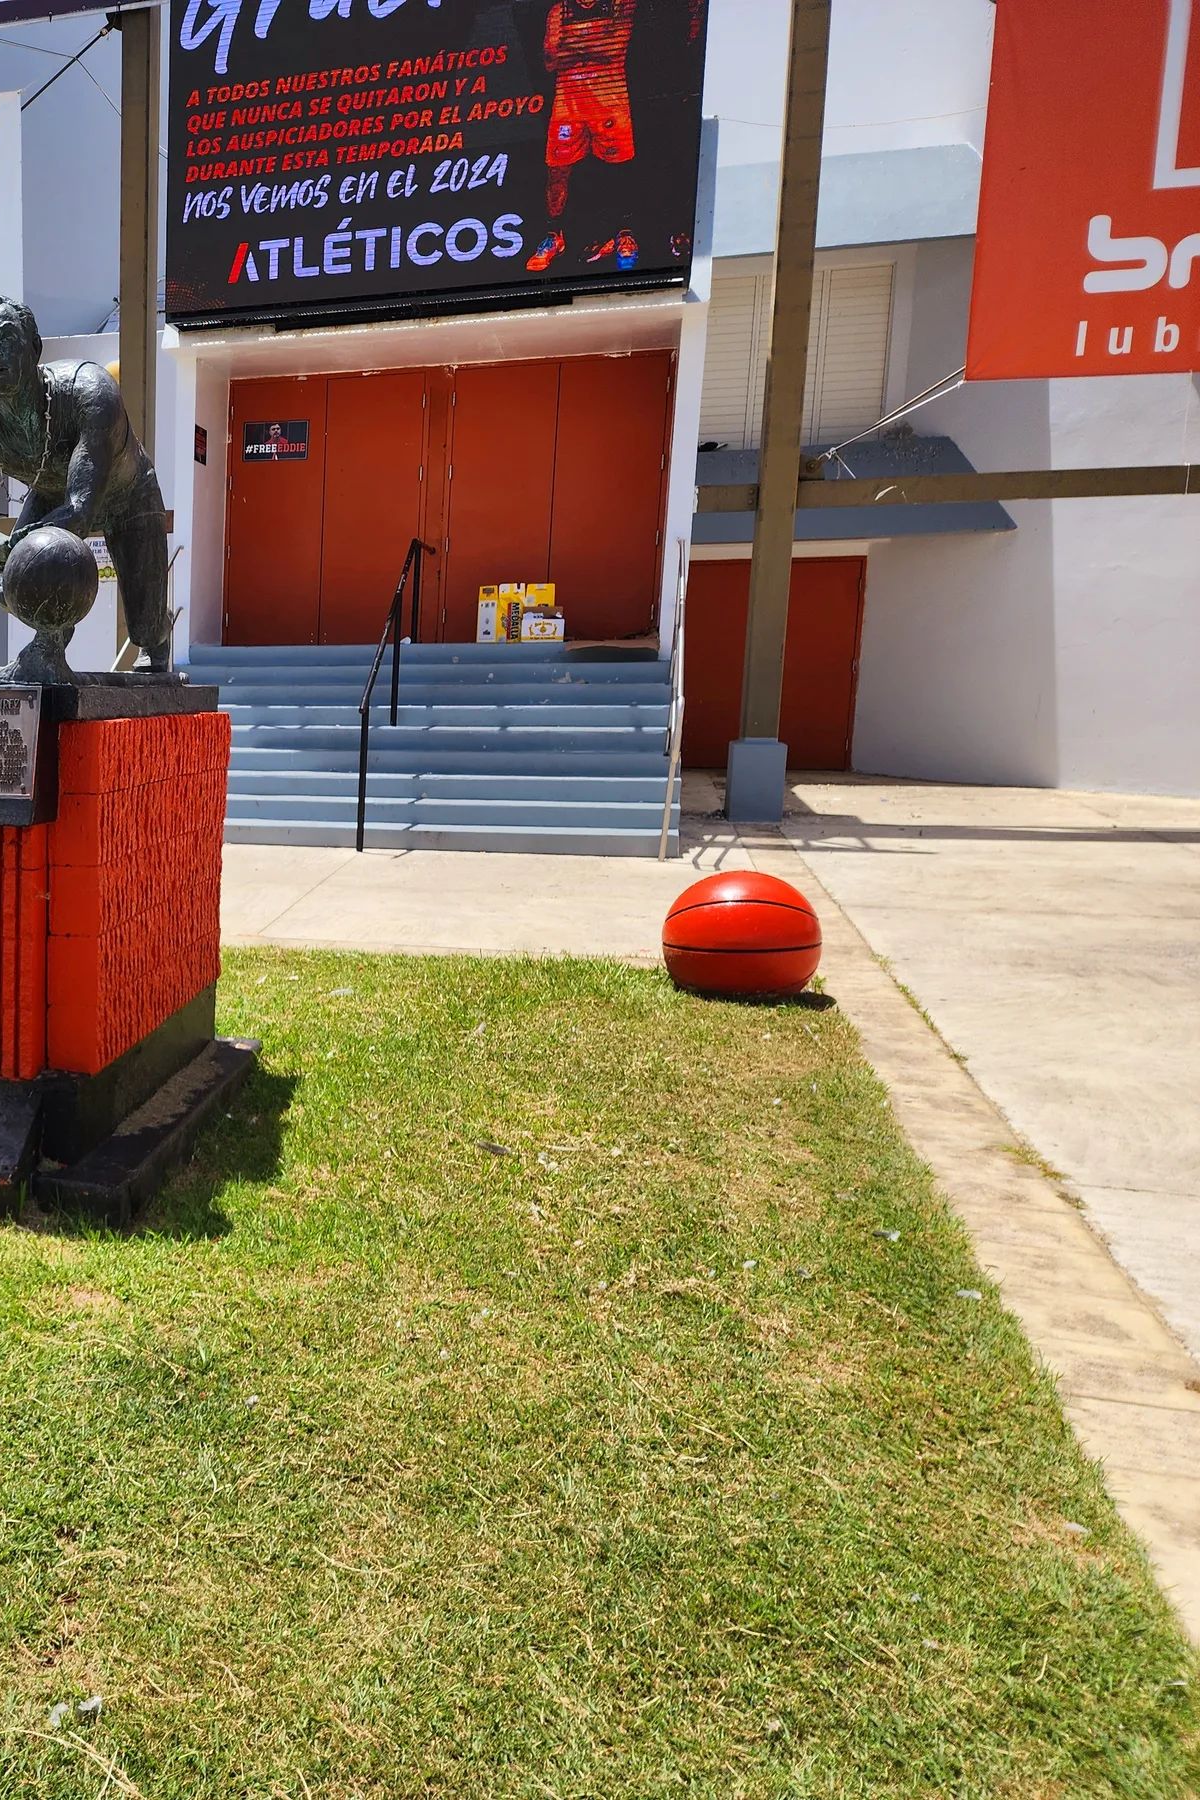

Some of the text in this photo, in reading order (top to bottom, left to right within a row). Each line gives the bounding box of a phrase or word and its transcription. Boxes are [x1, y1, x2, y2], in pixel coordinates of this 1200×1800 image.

[186, 45, 508, 107] A TODOS NUESTROS FANÁTICOS
[186, 76, 486, 135] QUE NUNCA SE QUITARON Y A
[186, 94, 544, 157] LOS AUSPICIADORES POR EL APOYO
[185, 131, 464, 183] DURANTE ESTA TEMPORADA
[240, 174, 332, 214] VEMOS
[430, 153, 508, 193] 2024
[228, 213, 524, 284] ATLÉTICOS
[1076, 316, 1200, 356] lub
